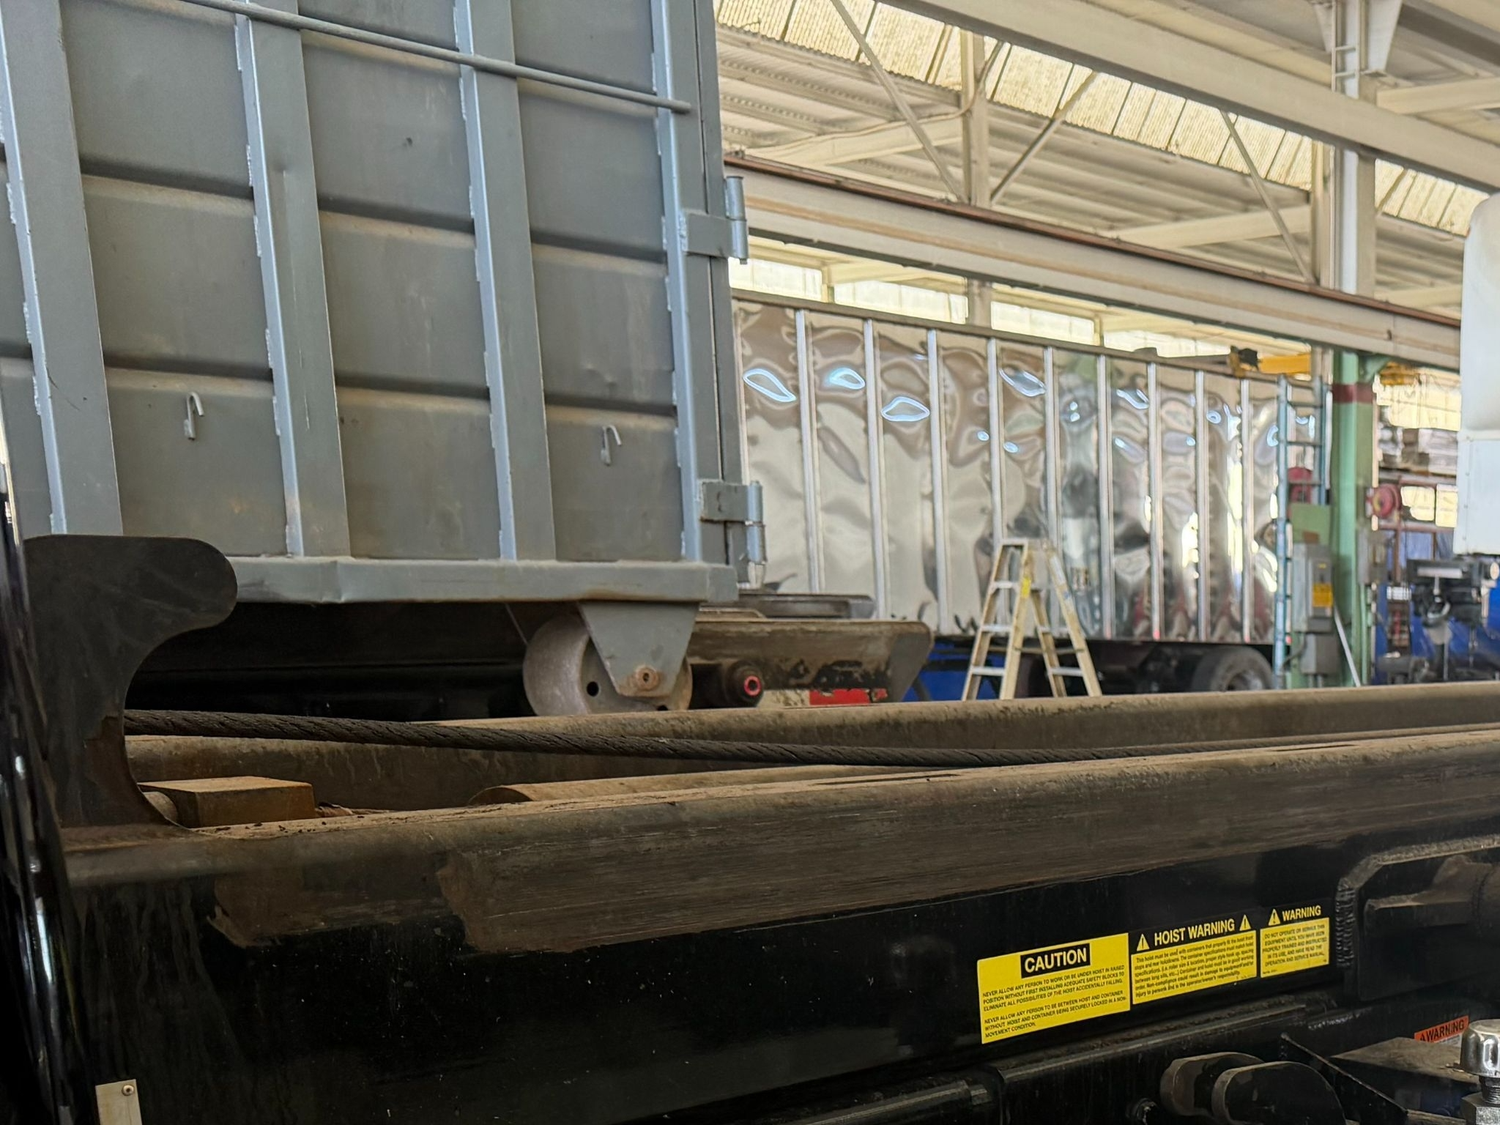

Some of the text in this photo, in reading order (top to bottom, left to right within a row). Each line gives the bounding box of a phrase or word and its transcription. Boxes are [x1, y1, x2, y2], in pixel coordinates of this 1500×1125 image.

[1282, 905, 1321, 922] WARNING
[1154, 918, 1235, 946] HOIST WARNING
[1024, 947, 1087, 973] CAUTION
[1426, 1019, 1465, 1042] WARNING
